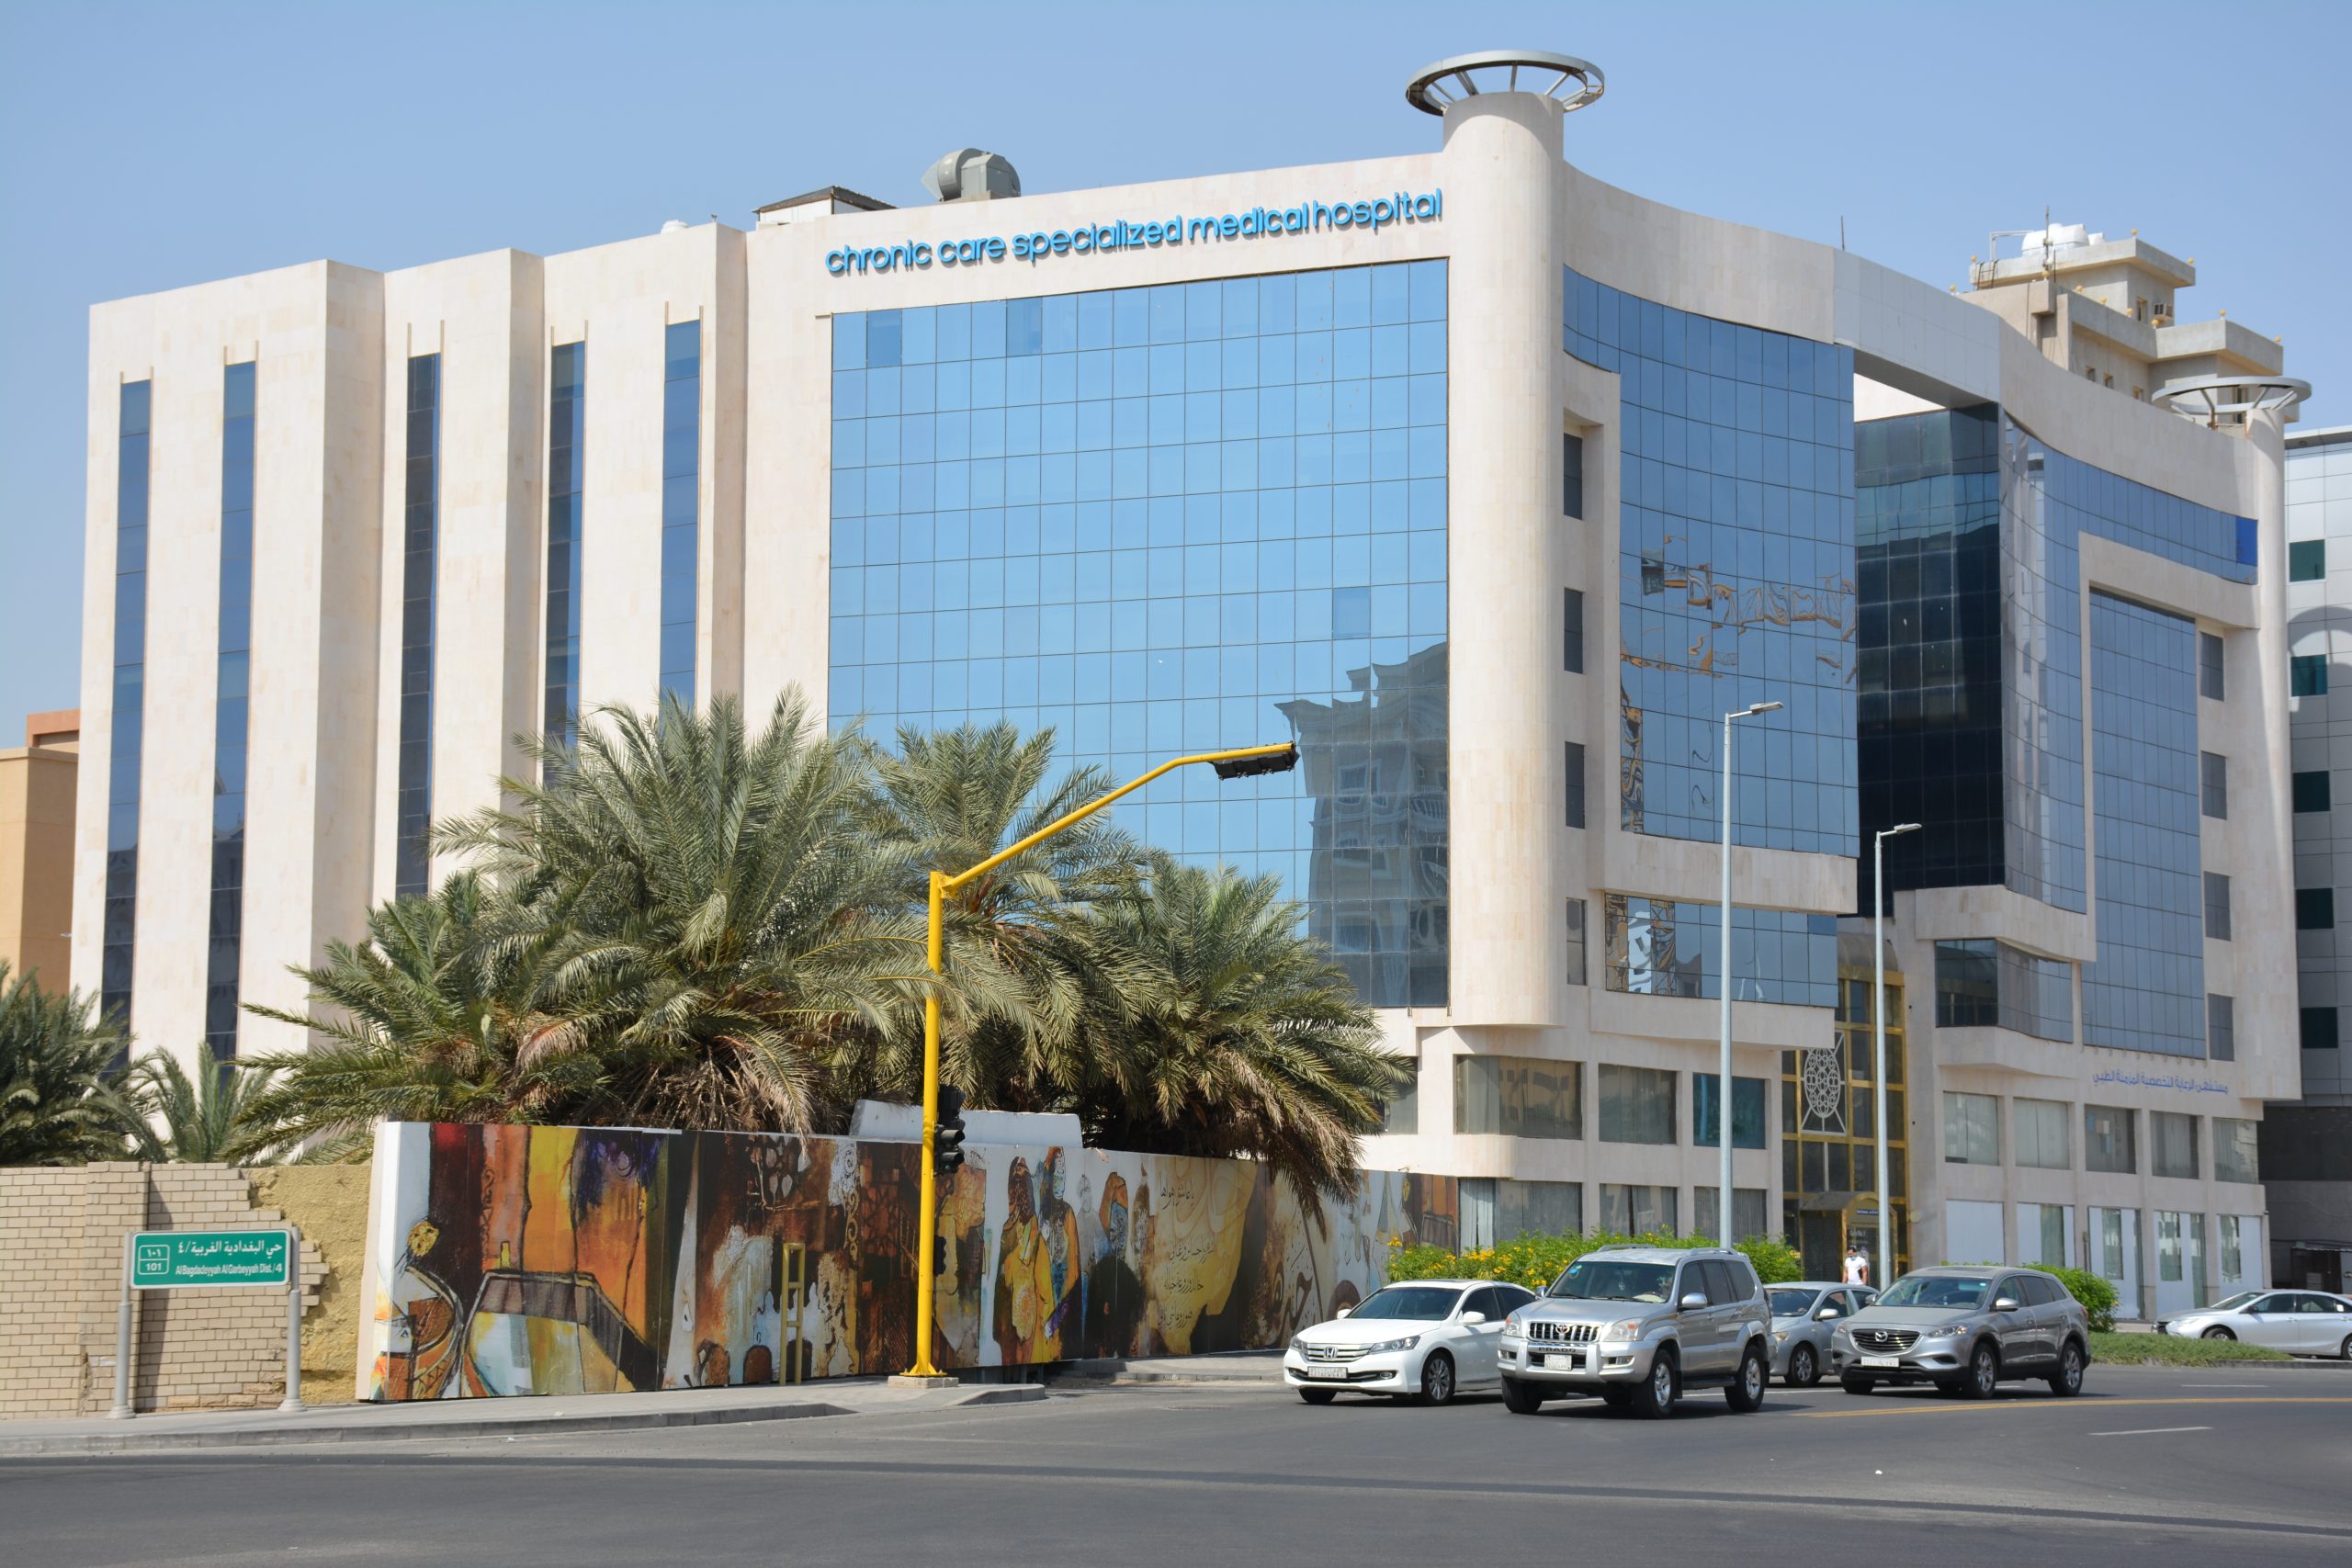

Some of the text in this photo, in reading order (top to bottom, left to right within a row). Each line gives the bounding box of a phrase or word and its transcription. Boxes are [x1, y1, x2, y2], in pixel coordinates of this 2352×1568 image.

[825, 187, 1442, 273] chronic care specialized medical hospital
[223, 1240, 265, 1256] البغدادية
[266, 1245, 283, 1258] حي
[145, 1262, 162, 1271] 101
